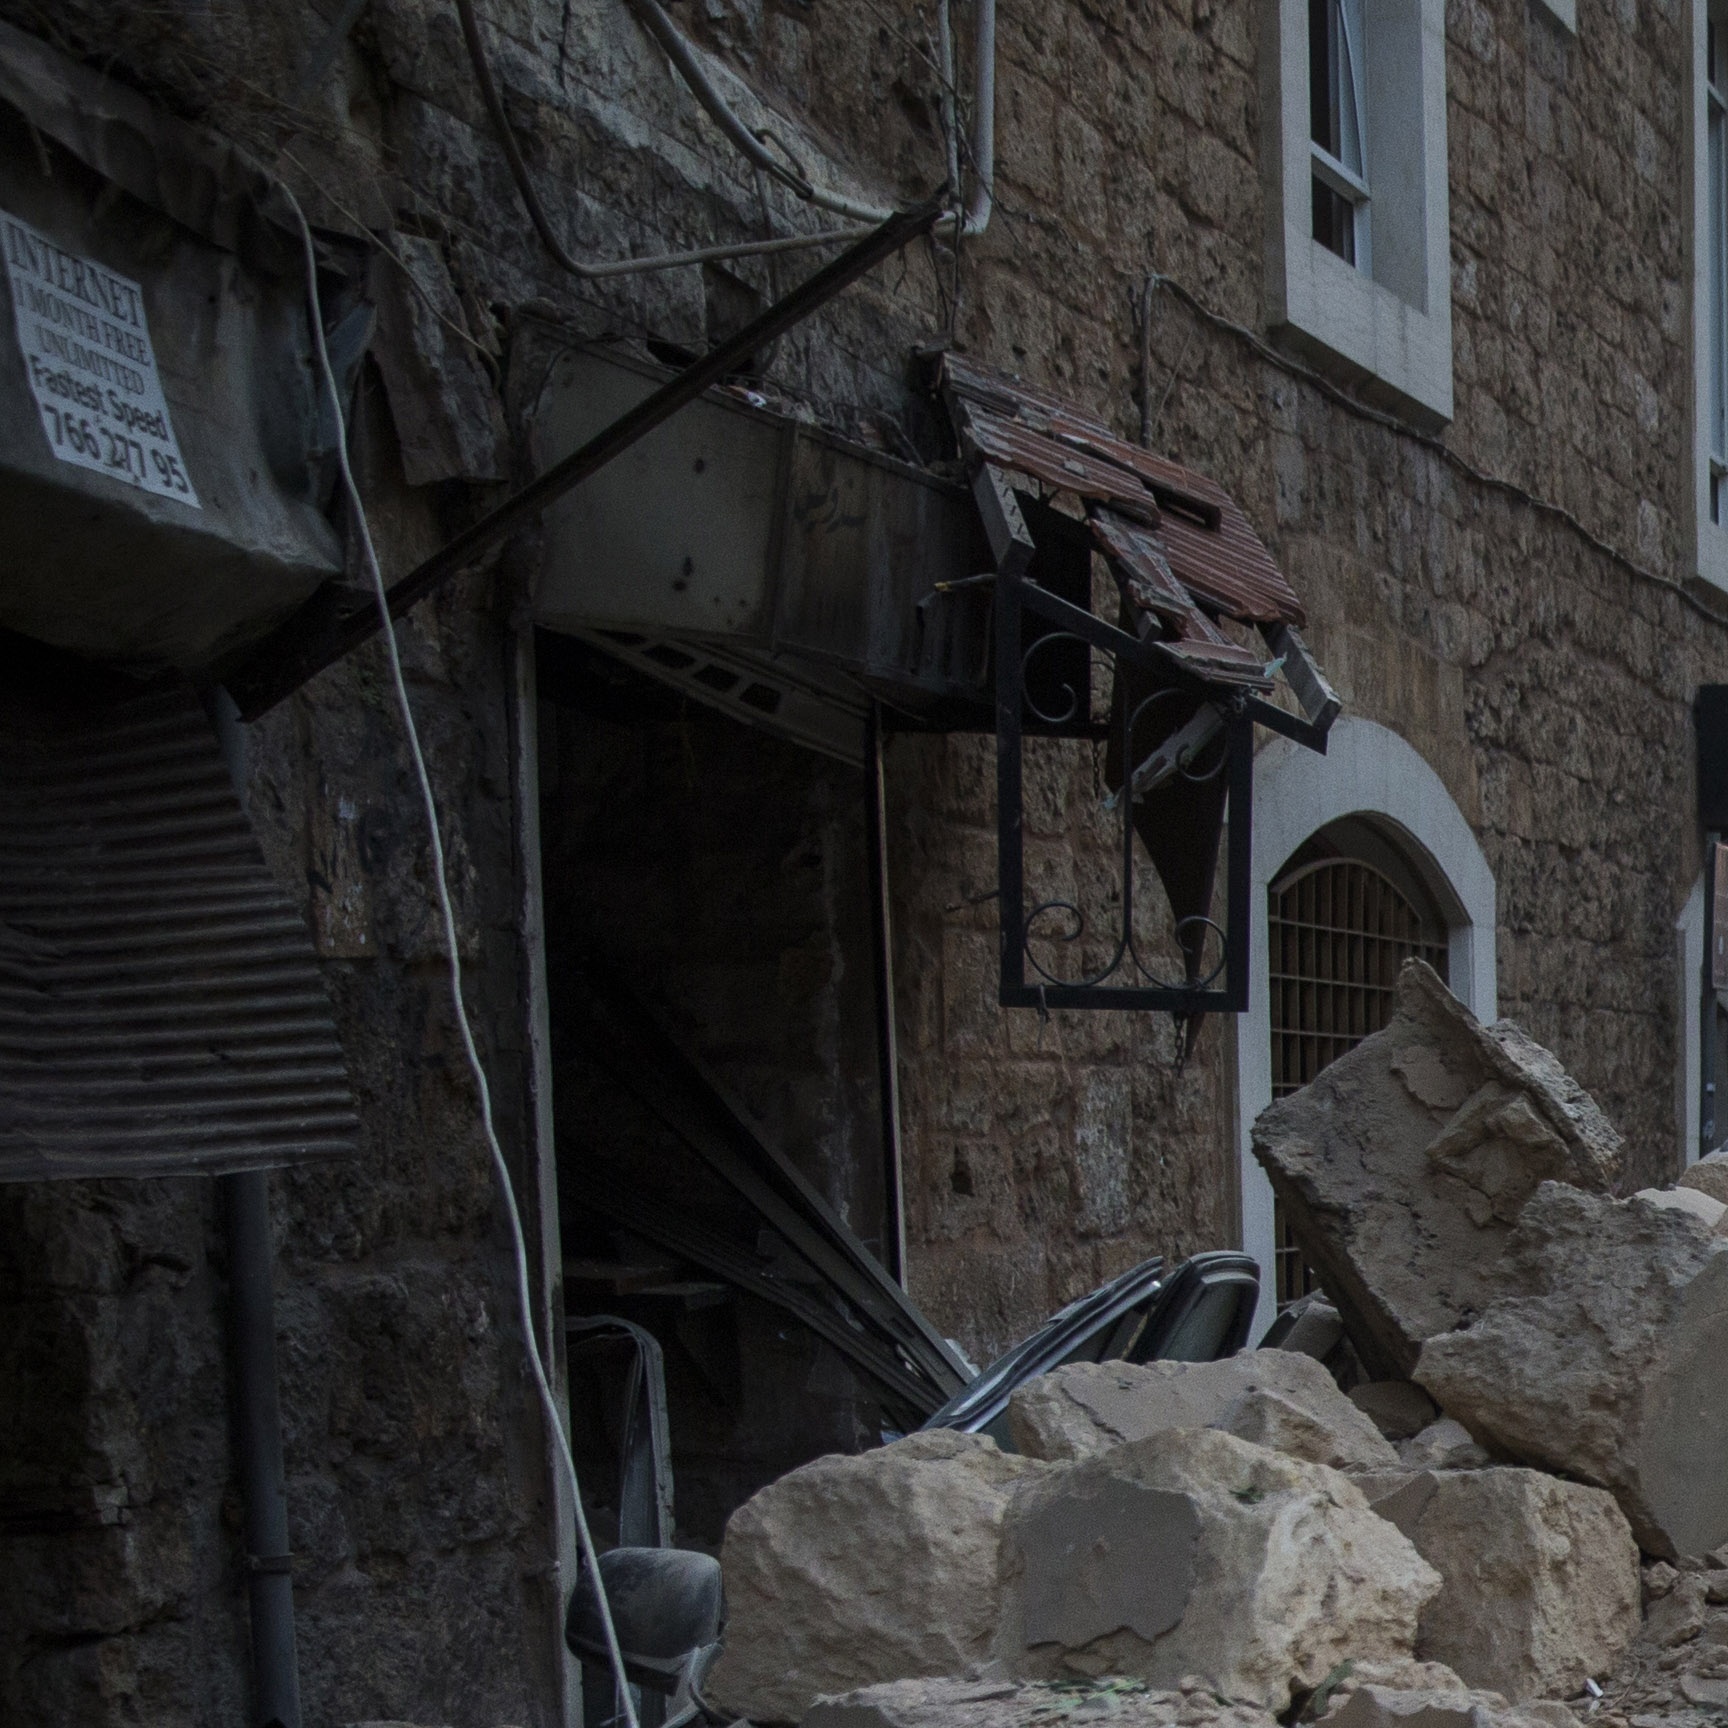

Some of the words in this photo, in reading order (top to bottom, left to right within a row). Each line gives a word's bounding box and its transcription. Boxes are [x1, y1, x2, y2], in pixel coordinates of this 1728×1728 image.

[6, 221, 141, 328] INTERNET
[27, 282, 102, 343] MONTH
[101, 319, 150, 367] FREE
[30, 355, 108, 414] Fastest
[107, 387, 169, 442] Speed
